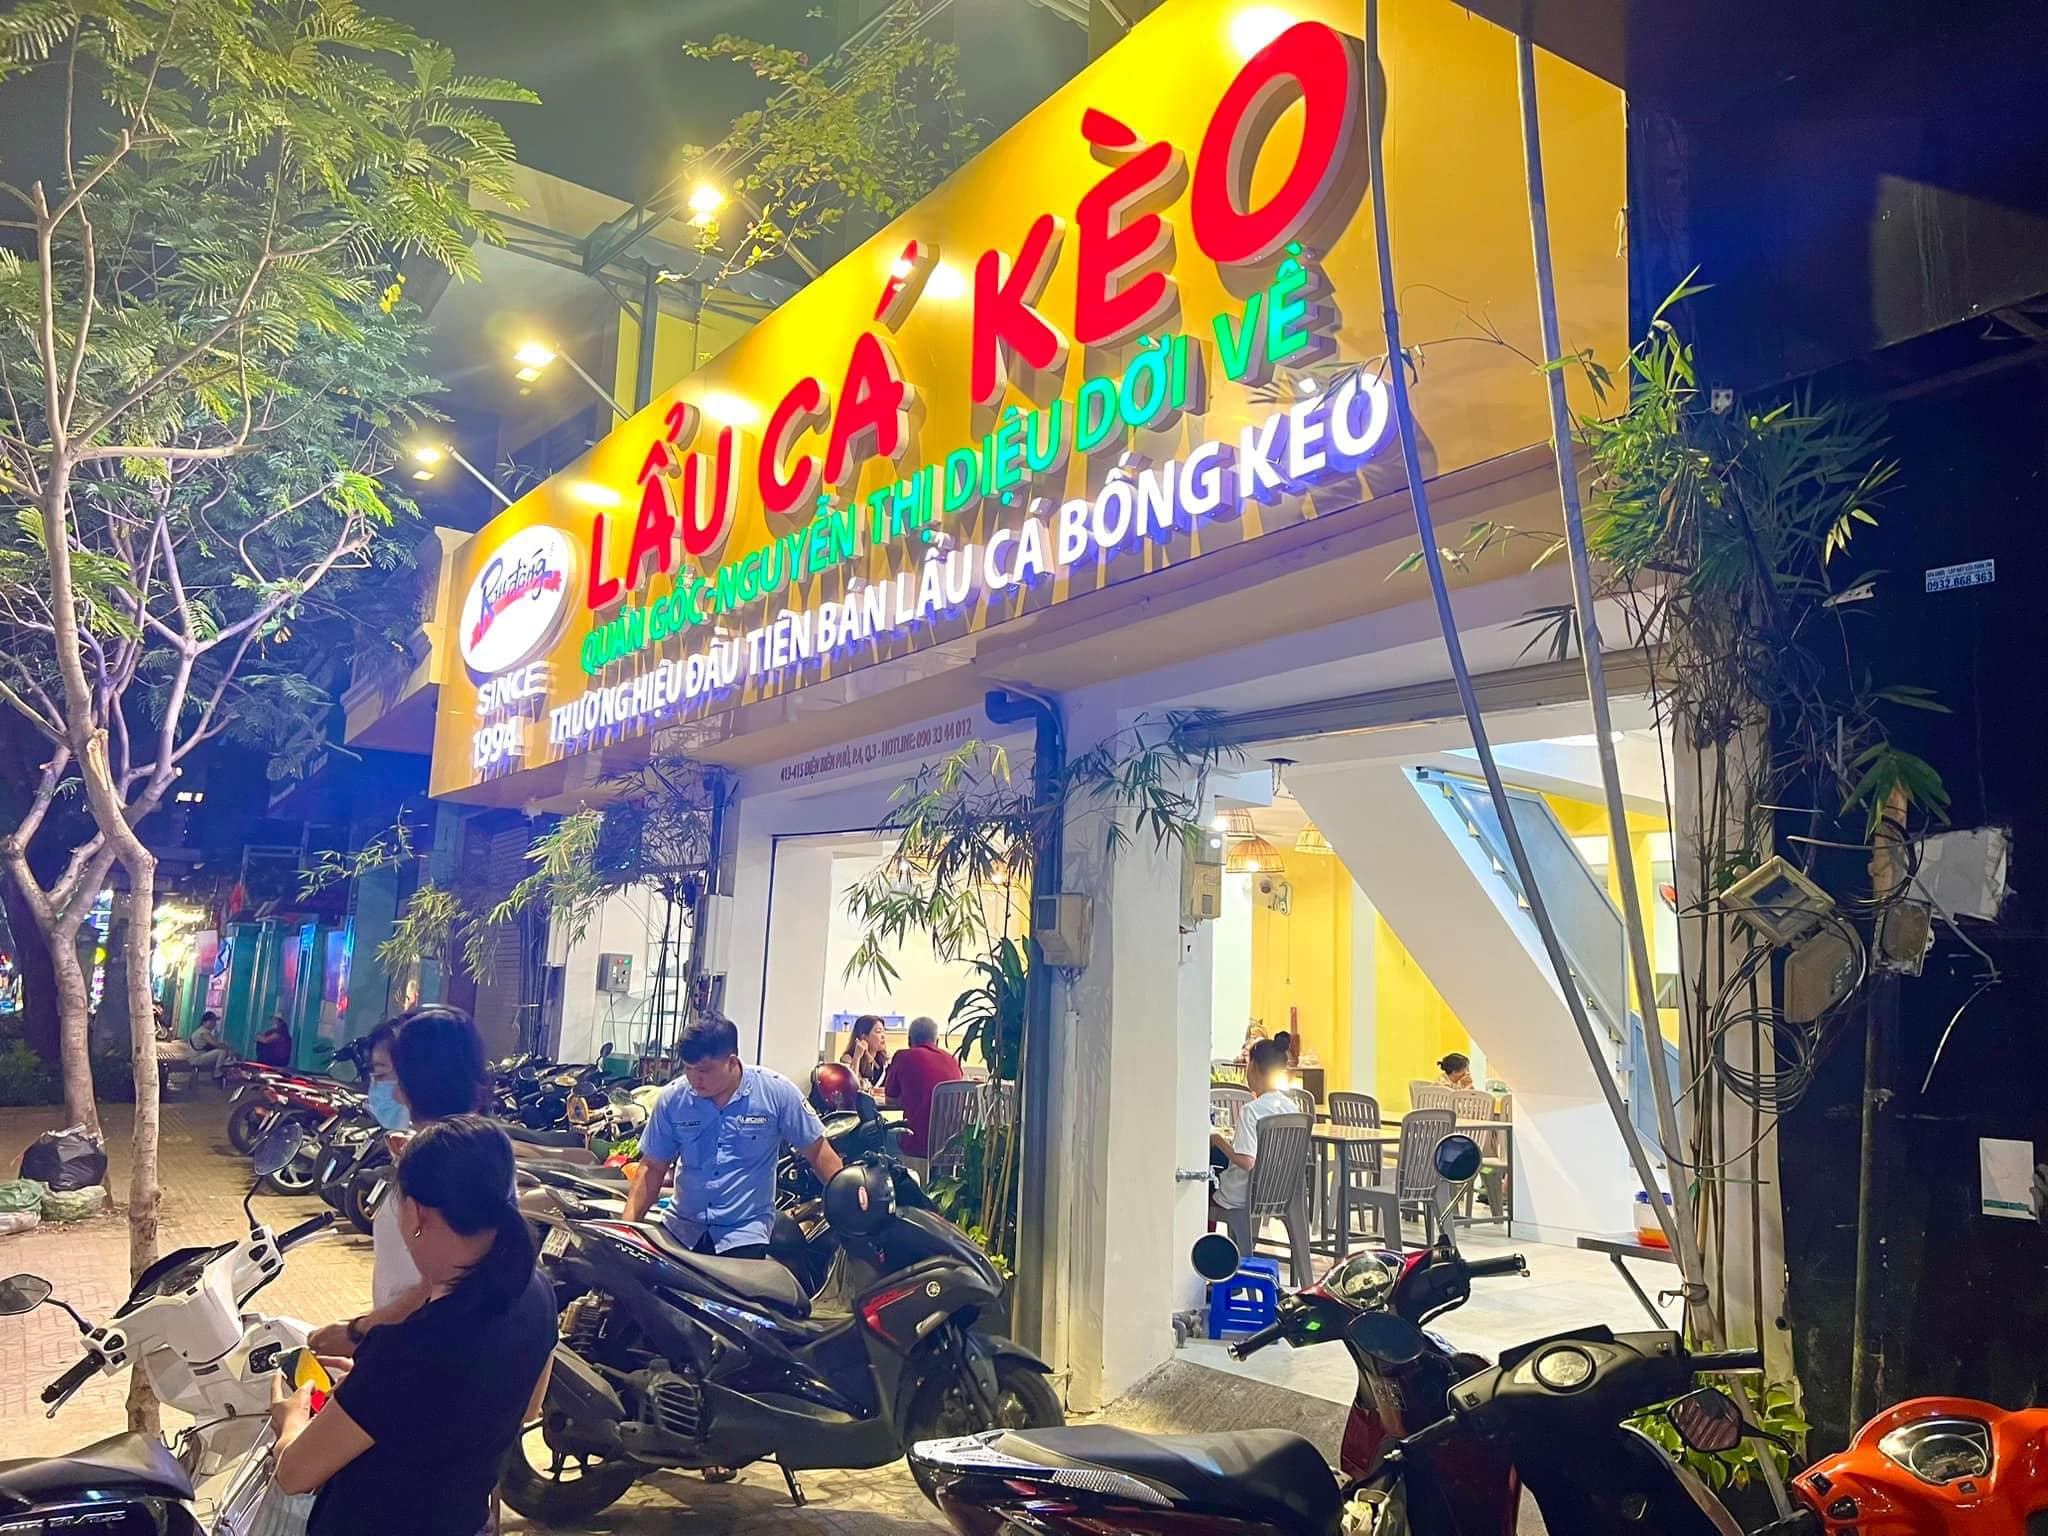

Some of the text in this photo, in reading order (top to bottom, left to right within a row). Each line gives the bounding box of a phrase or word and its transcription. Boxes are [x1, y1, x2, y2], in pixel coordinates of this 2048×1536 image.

[588, 20, 1350, 609] LẨU CÁ KÈO
[550, 373, 1389, 744] THƯƠNG HIỆU ĐẦU TIÊN BÁN LẨU CÁ BỐNG KÈO
[581, 604, 646, 676] QUÁN
[867, 464, 934, 544] THỊ
[943, 400, 1063, 513] DIỆU
[1077, 333, 1188, 454] DỜI
[1212, 240, 1308, 381] VỀ
[474, 716, 518, 769] 1994
[477, 660, 551, 715] SINCE
[916, 728, 931, 748] 090
[932, 725, 942, 744] 33
[944, 721, 955, 741] 44
[956, 718, 972, 738] 012
